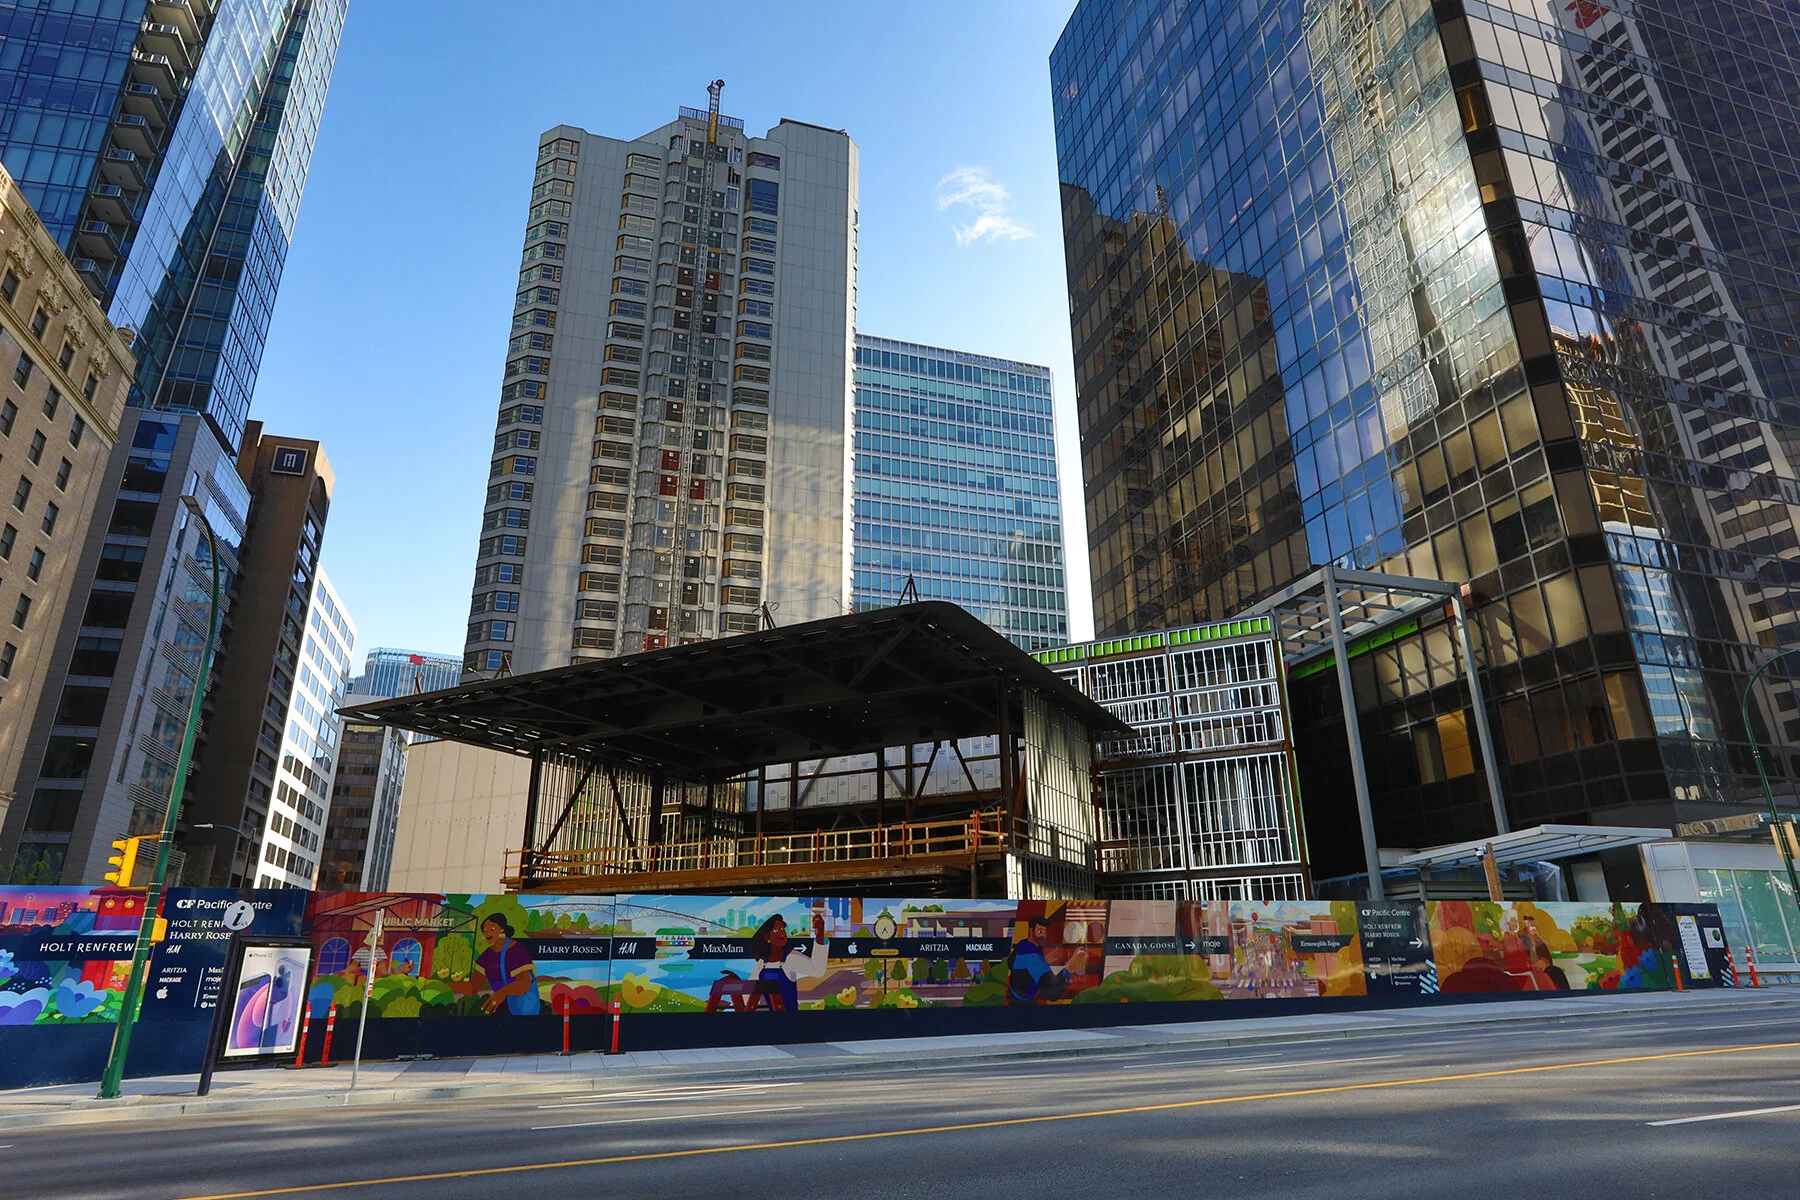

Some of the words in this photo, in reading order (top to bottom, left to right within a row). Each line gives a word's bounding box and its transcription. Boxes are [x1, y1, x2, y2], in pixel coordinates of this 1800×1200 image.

[176, 899, 196, 909] CF
[197, 899, 233, 910] Pacific
[1372, 909, 1390, 917] Pacific
[1391, 909, 1411, 917] Centre
[171, 919, 198, 928] HOLT
[414, 918, 454, 927] MARKET
[169, 931, 204, 940] HARRY
[205, 932, 232, 940] ROSE
[40, 942, 74, 952] HOLT
[77, 942, 135, 953] RENFREW
[702, 943, 744, 953] MaxMara
[919, 943, 950, 952] ARITZIA
[965, 943, 994, 952] MACKAGE
[1203, 940, 1221, 949] maje
[538, 945, 571, 954] HARRY
[572, 945, 603, 954] ROSEN
